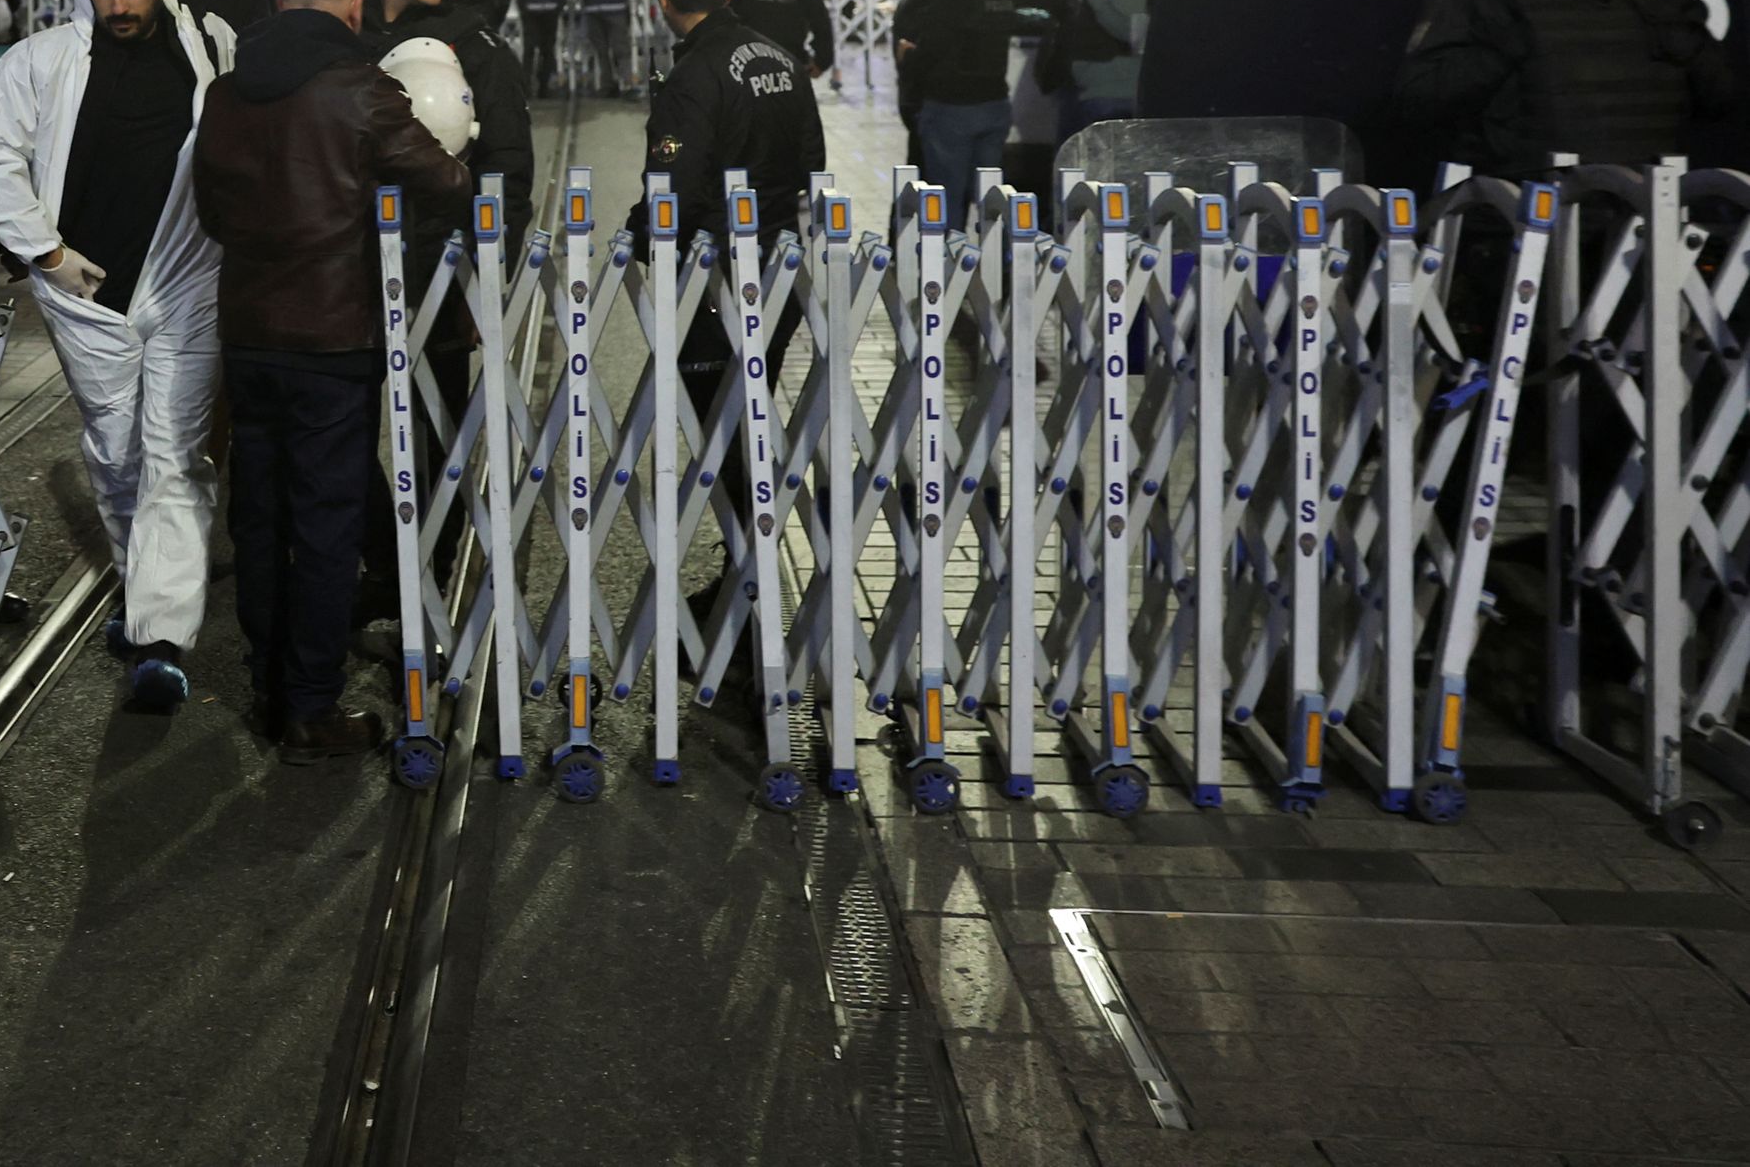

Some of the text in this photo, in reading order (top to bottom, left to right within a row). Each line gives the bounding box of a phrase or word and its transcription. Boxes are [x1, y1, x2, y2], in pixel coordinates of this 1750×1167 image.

[749, 71, 793, 97] POLİS
[389, 309, 412, 493] POLİS
[572, 312, 587, 498] POLİS
[745, 314, 771, 504] POLİS
[925, 313, 940, 505] POLİS
[1108, 312, 1124, 506] POLİS
[1300, 329, 1315, 524] POLİS
